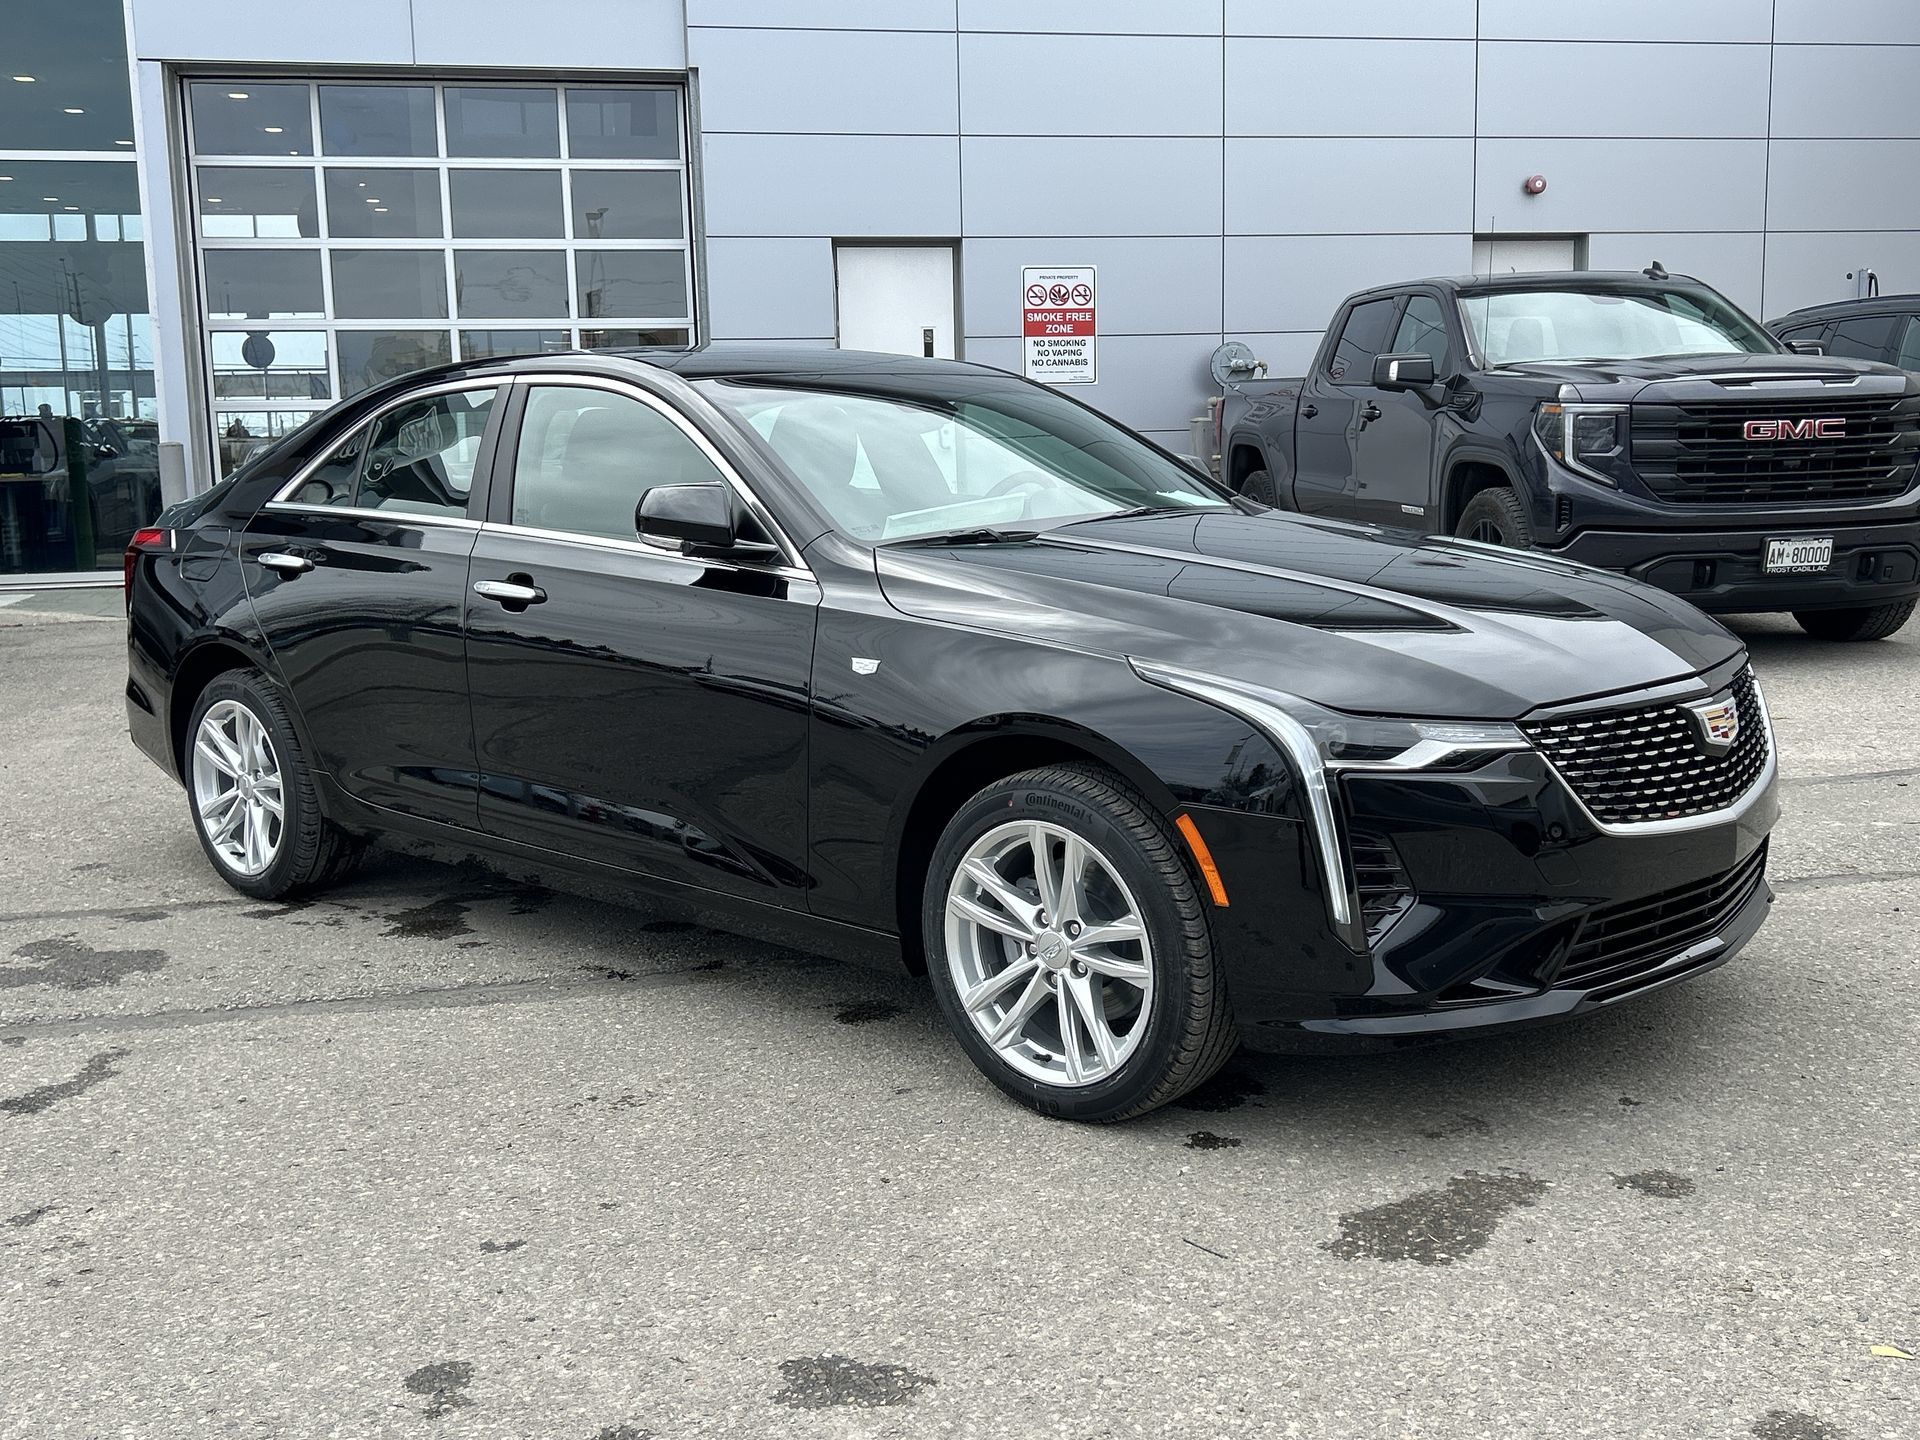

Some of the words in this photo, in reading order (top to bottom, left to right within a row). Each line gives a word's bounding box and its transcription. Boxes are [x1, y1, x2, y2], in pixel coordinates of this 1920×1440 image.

[1027, 313, 1063, 322] SMOKE
[1066, 312, 1092, 321] FREE
[1046, 324, 1073, 333] ZONE
[1048, 339, 1086, 347] SMOKING
[1037, 349, 1049, 357] NO
[1052, 349, 1082, 357] VAPING
[1032, 359, 1044, 367] NO
[1046, 358, 1088, 366] CANNABIS
[1744, 418, 1846, 440] GMC
[1769, 548, 1785, 565] AM
[1792, 546, 1830, 564] 80000
[1792, 565, 1828, 573] CADILLAC
[1026, 793, 1086, 819] Continental
